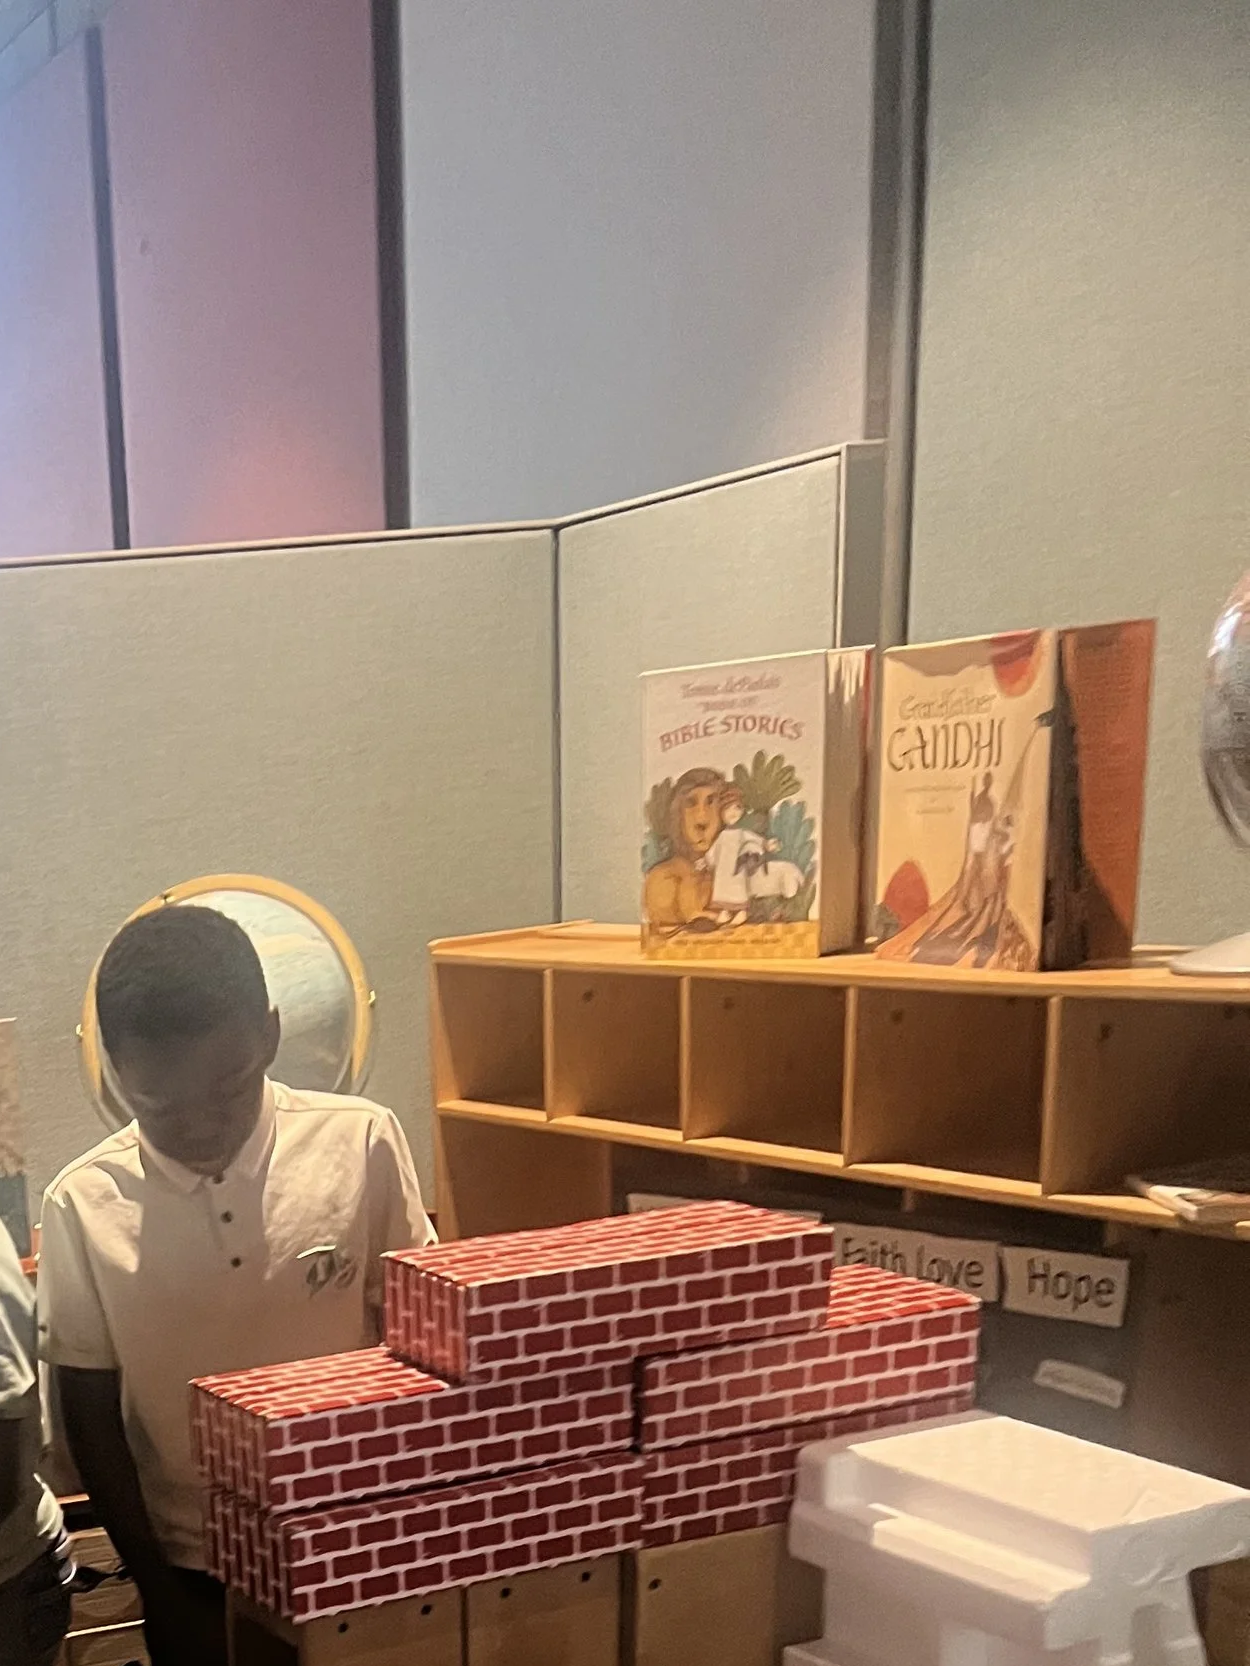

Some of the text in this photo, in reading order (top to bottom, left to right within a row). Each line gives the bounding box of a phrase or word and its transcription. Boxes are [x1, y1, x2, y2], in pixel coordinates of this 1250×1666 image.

[658, 713, 805, 752] BIBLE STORIES
[886, 717, 1006, 772] GANDHI
[1026, 1256, 1116, 1313] Hope
